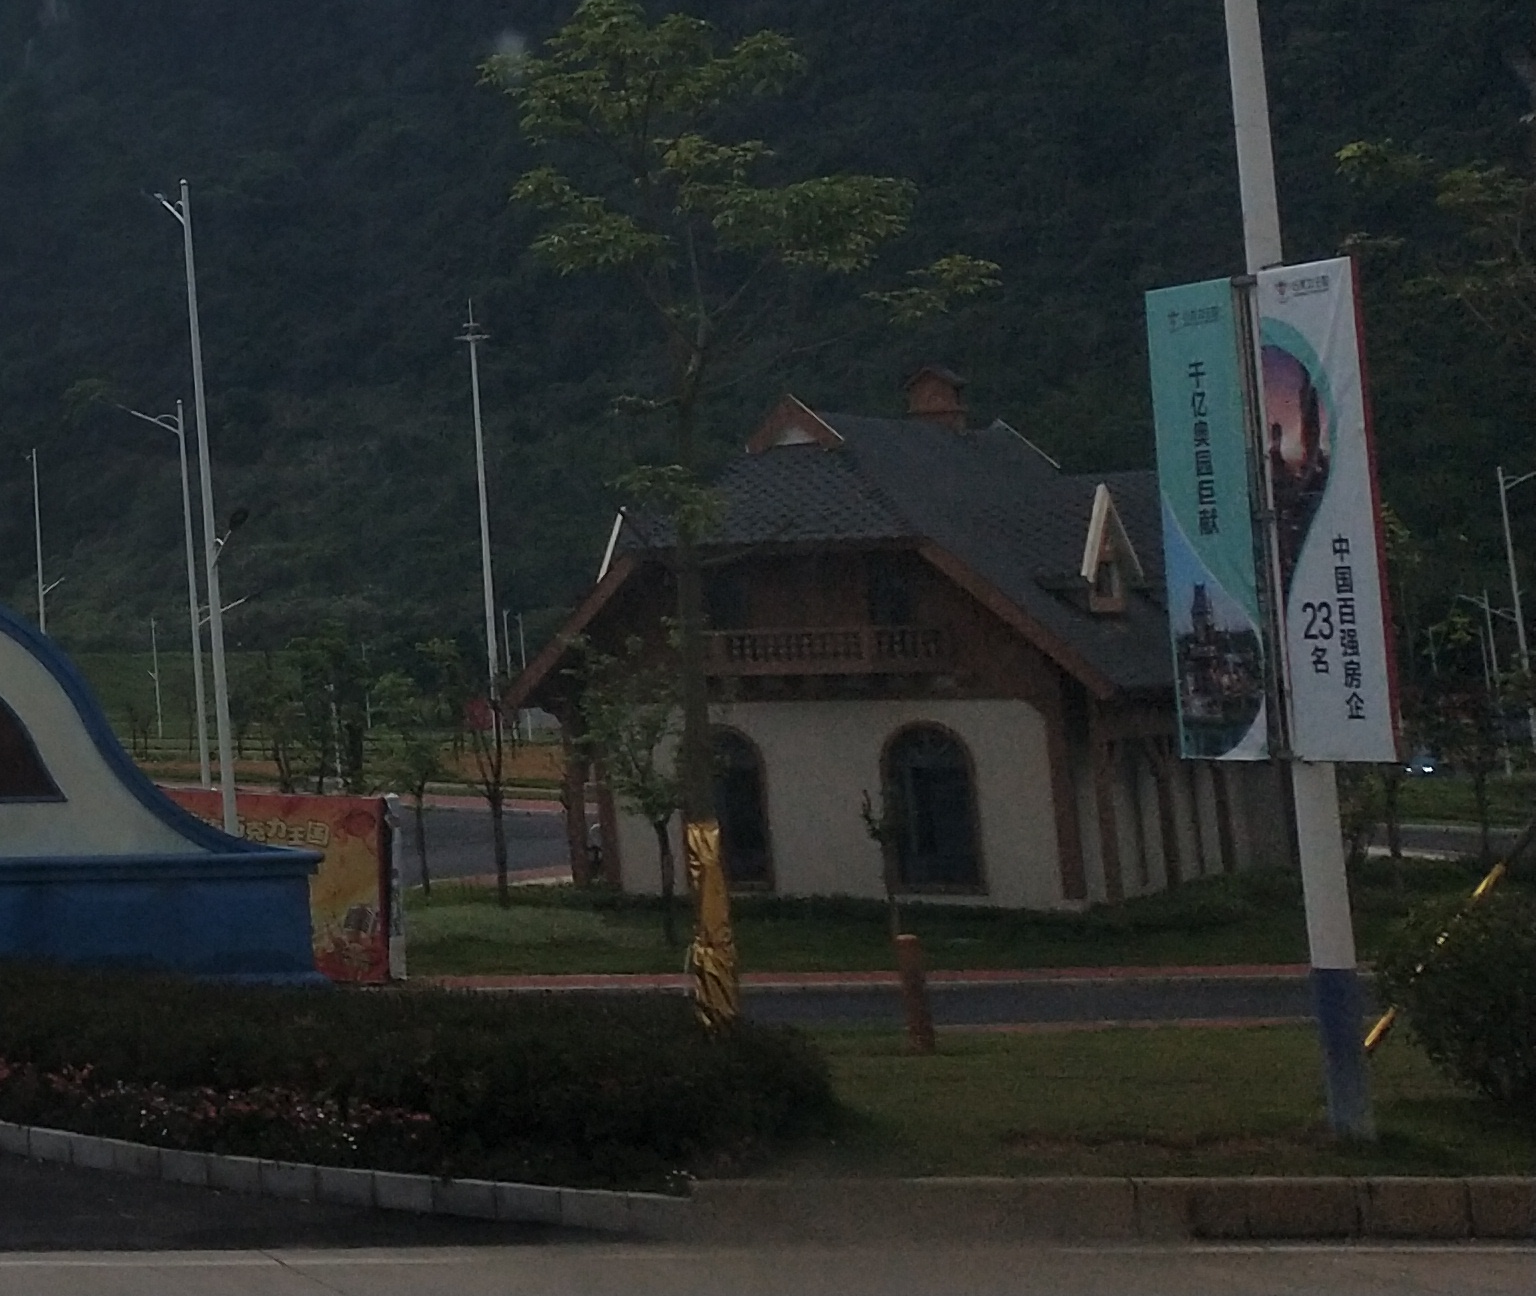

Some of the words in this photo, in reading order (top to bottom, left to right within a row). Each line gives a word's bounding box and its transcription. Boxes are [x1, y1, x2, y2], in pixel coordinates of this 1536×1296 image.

[1187, 360, 1219, 536] 千亿奥园巨献
[1331, 532, 1366, 720] 中国百强房企
